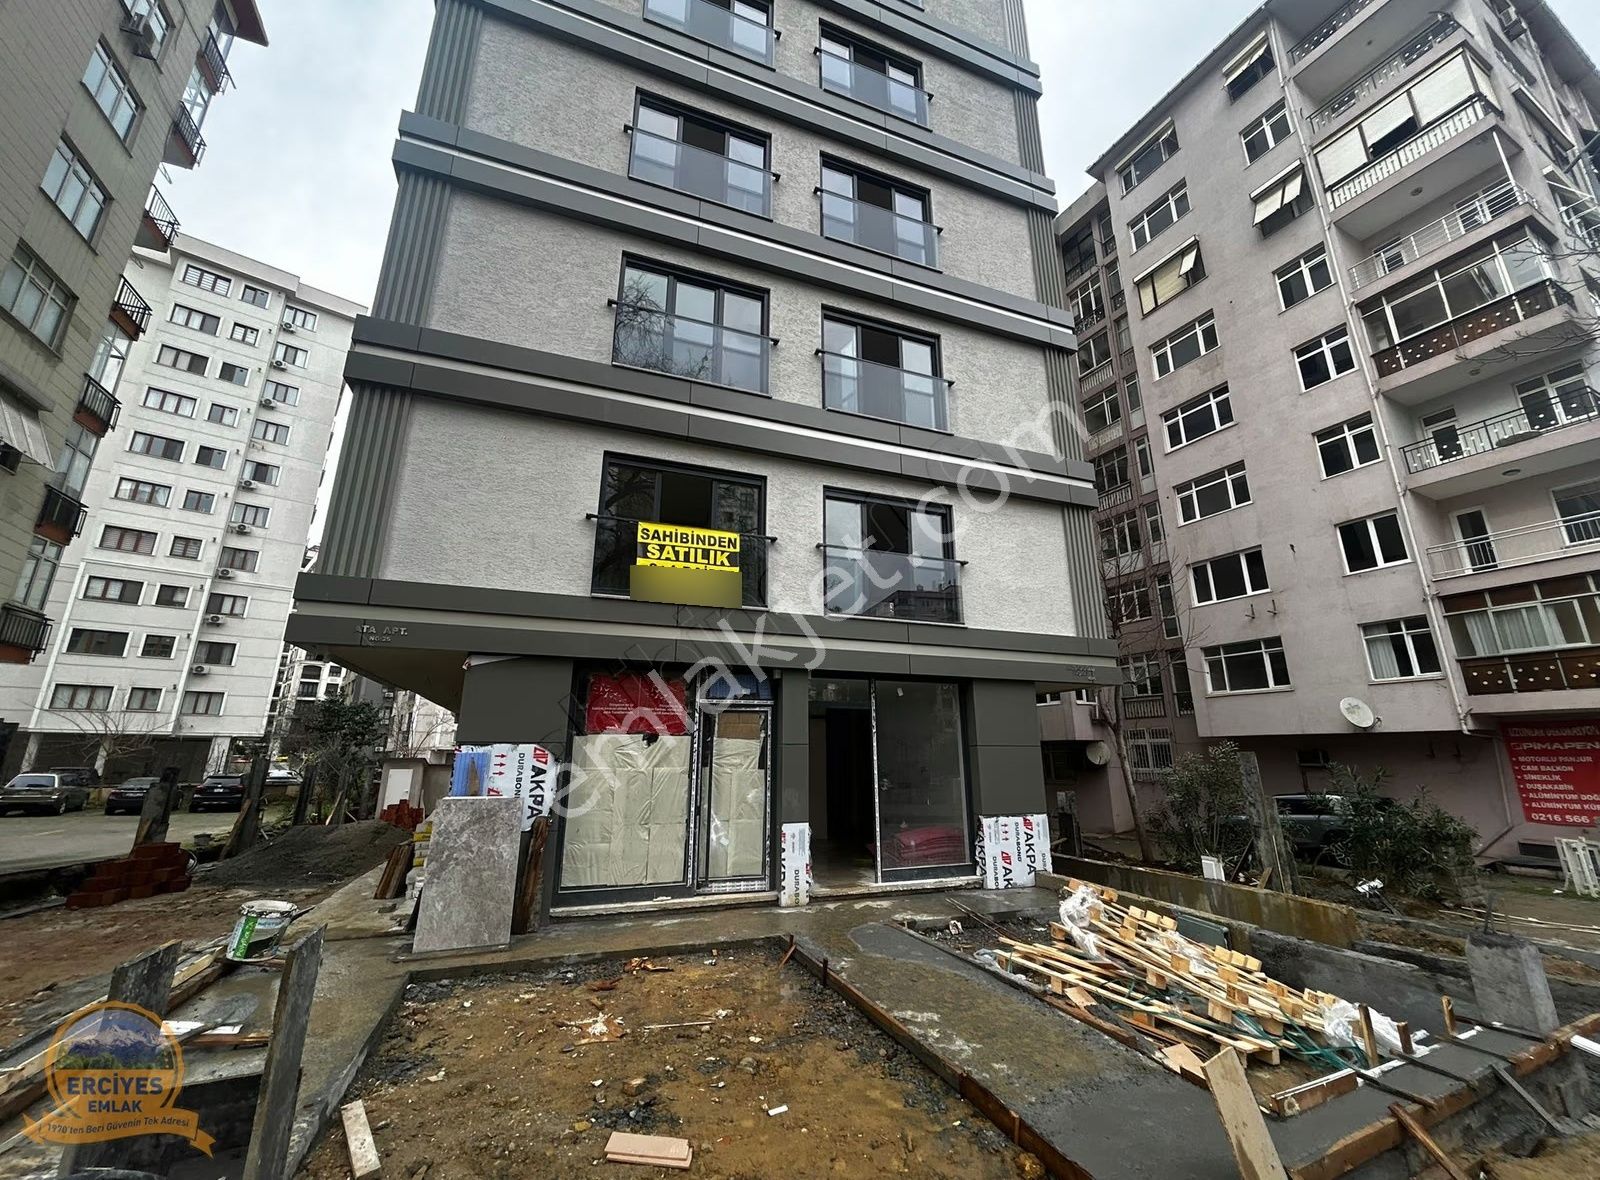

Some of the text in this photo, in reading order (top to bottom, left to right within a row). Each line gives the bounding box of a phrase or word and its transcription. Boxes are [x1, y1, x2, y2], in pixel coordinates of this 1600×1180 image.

[640, 528, 737, 549] SAHİBİNDEN
[646, 544, 730, 566] SATILIK
[514, 752, 525, 799] DURABON
[527, 765, 547, 820] AKPA
[1580, 793, 1600, 801] DOĞ
[1531, 813, 1561, 822] 0216
[1565, 814, 1590, 823] 566
[1024, 831, 1036, 876] AKPA
